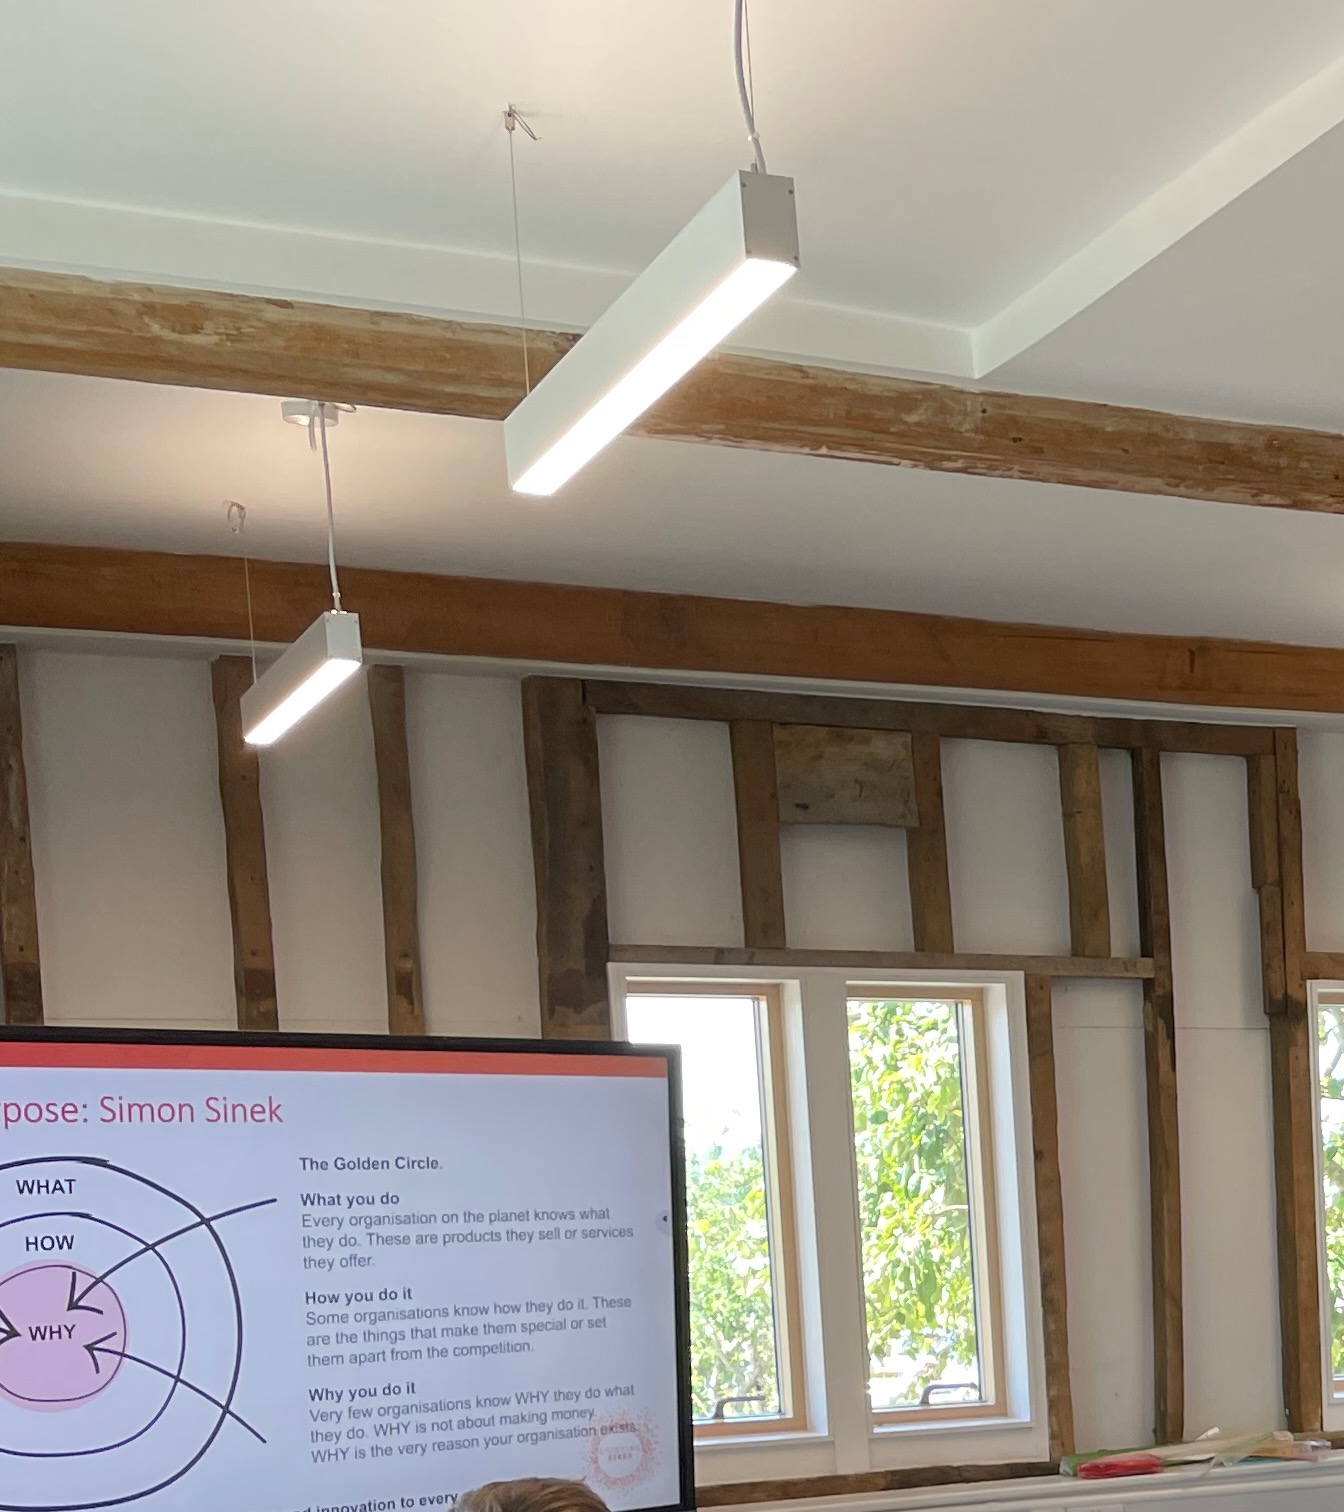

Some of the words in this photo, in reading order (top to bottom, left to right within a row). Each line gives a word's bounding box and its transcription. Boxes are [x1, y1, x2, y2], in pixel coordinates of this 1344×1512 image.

[2, 1101, 88, 1129] pose:
[100, 1096, 195, 1123] Simon
[205, 1096, 284, 1123] Sinek
[299, 1157, 329, 1171] The
[334, 1157, 390, 1170] Golden
[394, 1156, 443, 1170] Circle.
[16, 1178, 76, 1195] WHAT
[300, 1193, 342, 1206] What
[346, 1194, 375, 1209] you
[380, 1192, 400, 1205] do
[302, 1213, 344, 1230] Every
[349, 1212, 437, 1229] organisation
[441, 1213, 459, 1224] on
[463, 1211, 485, 1223] the
[488, 1209, 530, 1225] planet
[534, 1208, 575, 1222] knows
[579, 1207, 610, 1220] what
[25, 1234, 75, 1251] HOW
[302, 1235, 334, 1251] they
[339, 1234, 361, 1248] do.
[366, 1232, 411, 1246] These
[415, 1233, 438, 1245] are
[442, 1230, 502, 1247] products
[506, 1228, 534, 1244] they
[538, 1227, 561, 1241] sell
[564, 1228, 577, 1240] or
[581, 1226, 634, 1239] services
[303, 1255, 335, 1272] they
[339, 1254, 375, 1268] offer.
[305, 1290, 340, 1305] How
[345, 1291, 374, 1306] you
[378, 1288, 398, 1301] do
[403, 1286, 412, 1300] it
[306, 1311, 349, 1325] Some
[353, 1307, 449, 1325] organisations
[453, 1304, 489, 1317] know
[493, 1302, 521, 1315] how
[526, 1300, 553, 1315] they
[557, 1299, 574, 1312] do
[592, 1296, 632, 1309] These
[28, 1324, 76, 1341] WHY
[306, 1334, 331, 1347] are
[335, 1331, 358, 1345] the
[363, 1329, 406, 1345] things
[410, 1326, 437, 1340] that
[440, 1323, 478, 1338] make
[483, 1321, 517, 1336] them
[520, 1317, 567, 1335] special
[570, 1319, 584, 1330] or
[587, 1316, 607, 1329] set
[307, 1354, 344, 1368] them
[349, 1350, 386, 1367] apart
[390, 1348, 422, 1361] from
[427, 1346, 449, 1359] the
[453, 1341, 534, 1358] competition.
[308, 1388, 344, 1403] Why
[349, 1386, 377, 1402] you
[382, 1383, 402, 1396] do
[406, 1381, 416, 1395] it
[309, 1409, 343, 1424] Very
[347, 1406, 373, 1419] few
[377, 1399, 472, 1419] organisations
[476, 1395, 511, 1409] know
[515, 1390, 550, 1405] WHY
[553, 1389, 581, 1404] they
[584, 1386, 601, 1399] do
[604, 1383, 635, 1398] what
[310, 1429, 342, 1445] they
[374, 1421, 412, 1437] WHY
[416, 1421, 427, 1434] is
[431, 1418, 453, 1432] not
[457, 1415, 496, 1430] about
[500, 1410, 548, 1426] making
[311, 1447, 350, 1464] WHY
[354, 1446, 366, 1459] is
[371, 1444, 393, 1458] the
[397, 1442, 427, 1456] very
[432, 1437, 479, 1452] reason
[484, 1434, 513, 1450] your
[517, 1425, 597, 1445] organisation
[400, 1496, 415, 1509] to
[419, 1493, 459, 1507] every
